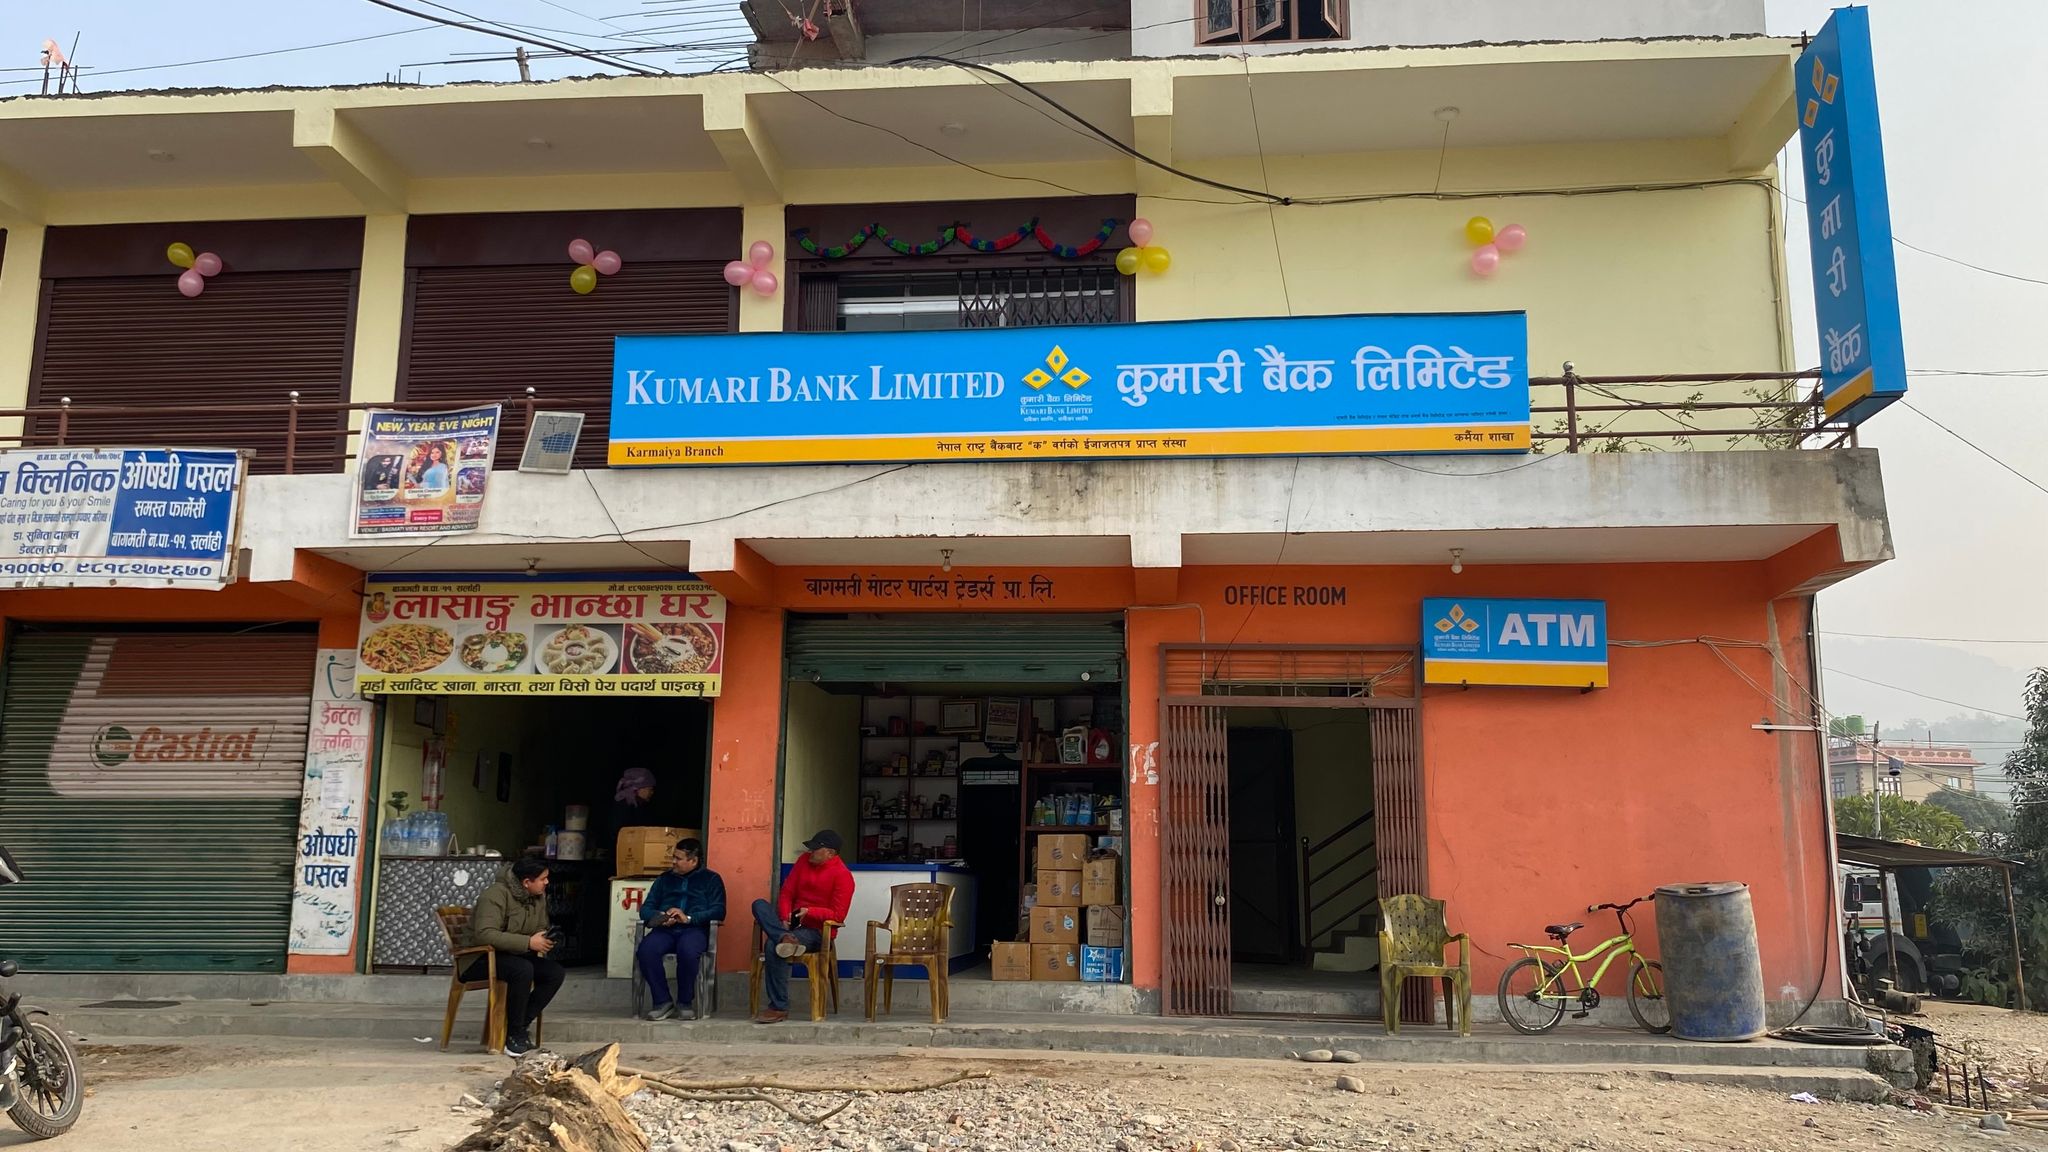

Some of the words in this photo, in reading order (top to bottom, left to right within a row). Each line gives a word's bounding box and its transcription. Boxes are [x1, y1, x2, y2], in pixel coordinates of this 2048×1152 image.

[625, 370, 761, 405] KUMARI
[768, 367, 860, 402] BANK
[869, 365, 1005, 401] LIMITED
[1116, 349, 1246, 408] कुमारी
[1254, 344, 1335, 393] बैंक
[1351, 344, 1514, 391] लिमिटेड
[1020, 407, 1046, 415] KUMARI
[376, 422, 403, 432] NEW
[408, 422, 435, 432] YEAR
[439, 420, 459, 431] EVE
[461, 416, 495, 428] NIGHT
[937, 441, 961, 451] नेपाल
[967, 442, 985, 453] राष्ट्र
[1052, 438, 1078, 449] वर्गको
[1084, 438, 1131, 449] ईजाजतपत्र
[1136, 439, 1157, 449] प्राप्त
[1162, 437, 1186, 448] संस्था
[1489, 432, 1515, 442] शाखा
[627, 447, 681, 459] Karmaiya
[685, 446, 724, 457] Branch
[15, 461, 119, 494] क्लिनिक
[121, 452, 182, 490] औषधी
[186, 463, 235, 492] पसल
[1, 497, 26, 509] Caring
[29, 496, 40, 507] for
[42, 498, 57, 509] you
[60, 498, 65, 506] &
[67, 498, 86, 509] your
[87, 496, 111, 506] Smile
[135, 500, 167, 518] समस्त
[112, 528, 147, 547] बागमती
[804, 574, 862, 598] बागमती
[867, 574, 904, 598] मोटर
[1225, 586, 1287, 605] OFFICE
[1293, 586, 1346, 605] ROOM
[530, 594, 648, 619] भान्छा
[659, 594, 717, 619] घर
[1498, 613, 1595, 647] ATM
[390, 678, 438, 691] स्वादिष्ट
[529, 681, 555, 691] तथा
[560, 679, 589, 691] चिसो
[595, 679, 616, 691] पेय
[621, 679, 655, 691] पदार्थ
[134, 727, 259, 763] Castrol
[302, 826, 357, 857] औषधी
[304, 864, 350, 888] पसल
